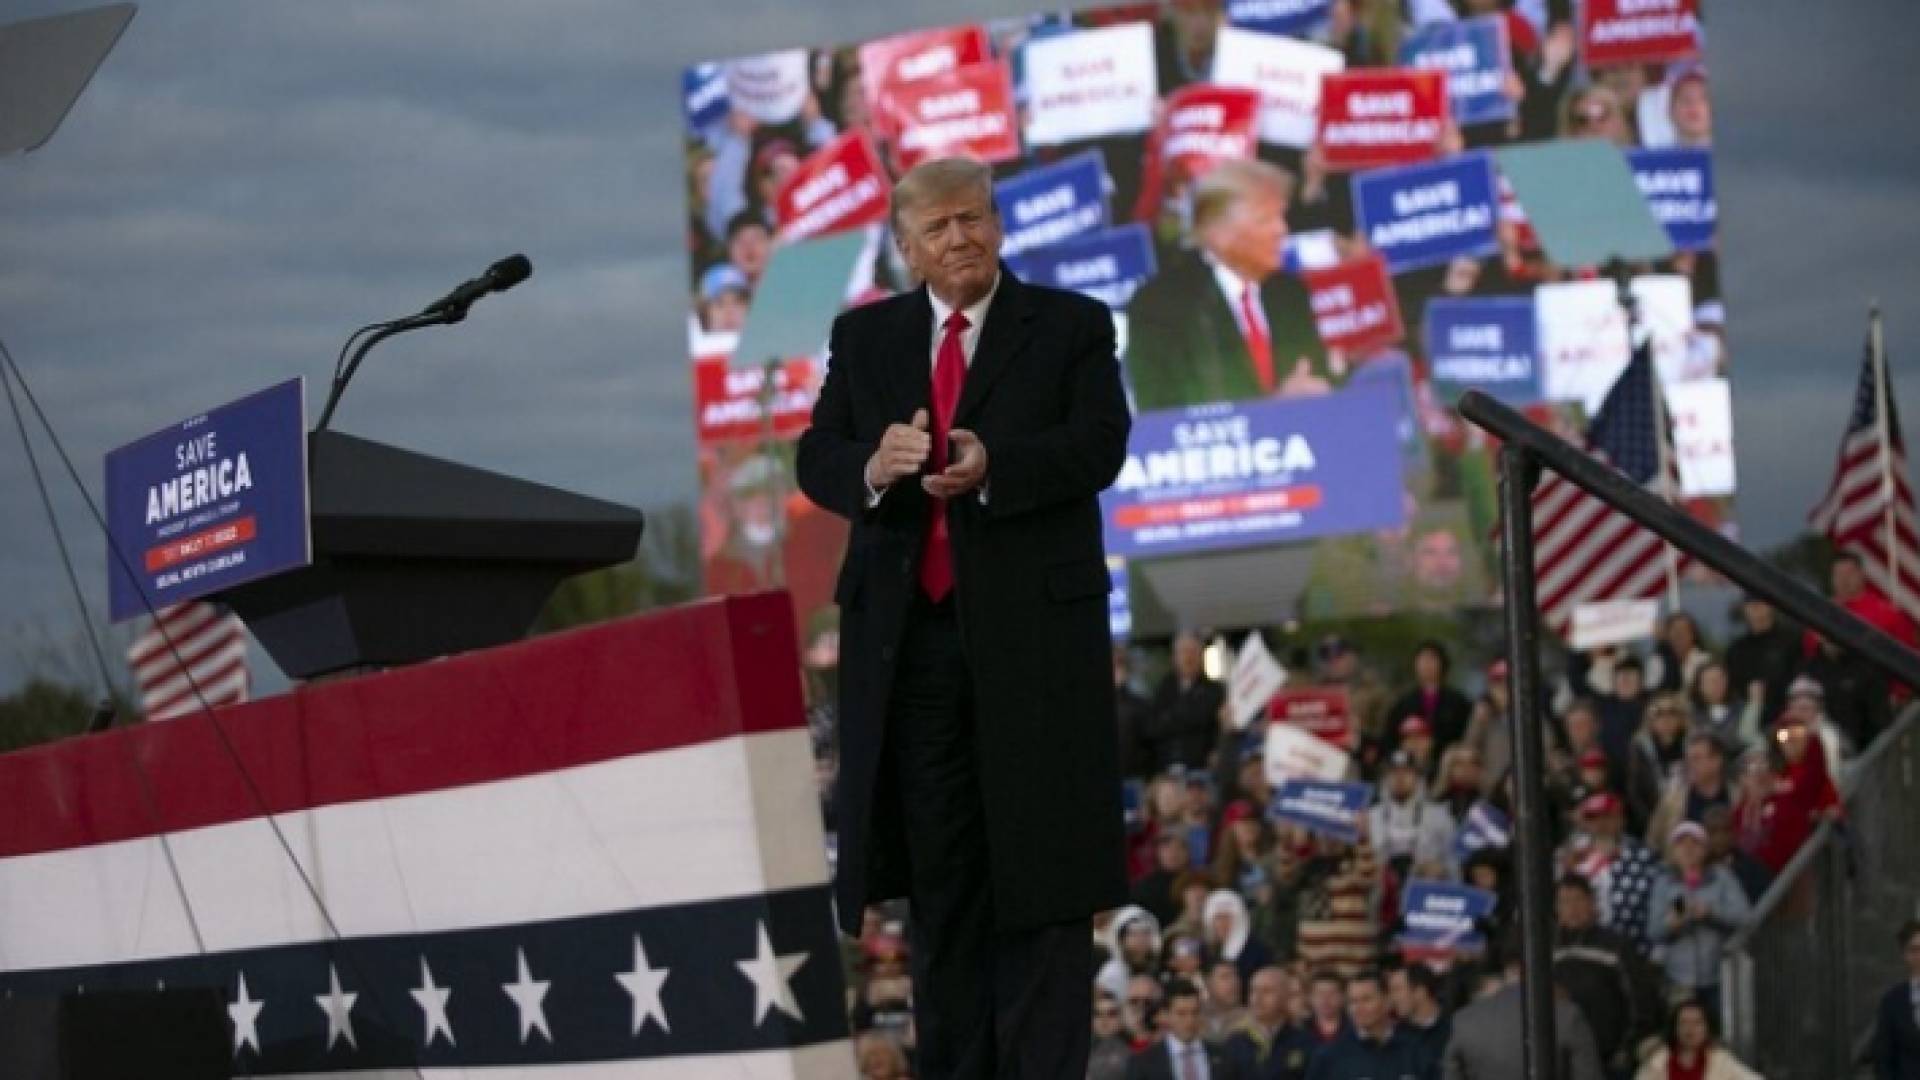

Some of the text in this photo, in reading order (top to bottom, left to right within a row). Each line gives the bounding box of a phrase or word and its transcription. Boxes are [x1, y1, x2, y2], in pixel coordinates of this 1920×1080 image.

[1347, 91, 1413, 116] SAVE
[1393, 182, 1460, 214] SAVE
[1174, 416, 1248, 446] SAVE
[175, 431, 216, 471] SAVE
[1117, 433, 1316, 490] AMERICA
[146, 451, 253, 524] AMERICA
